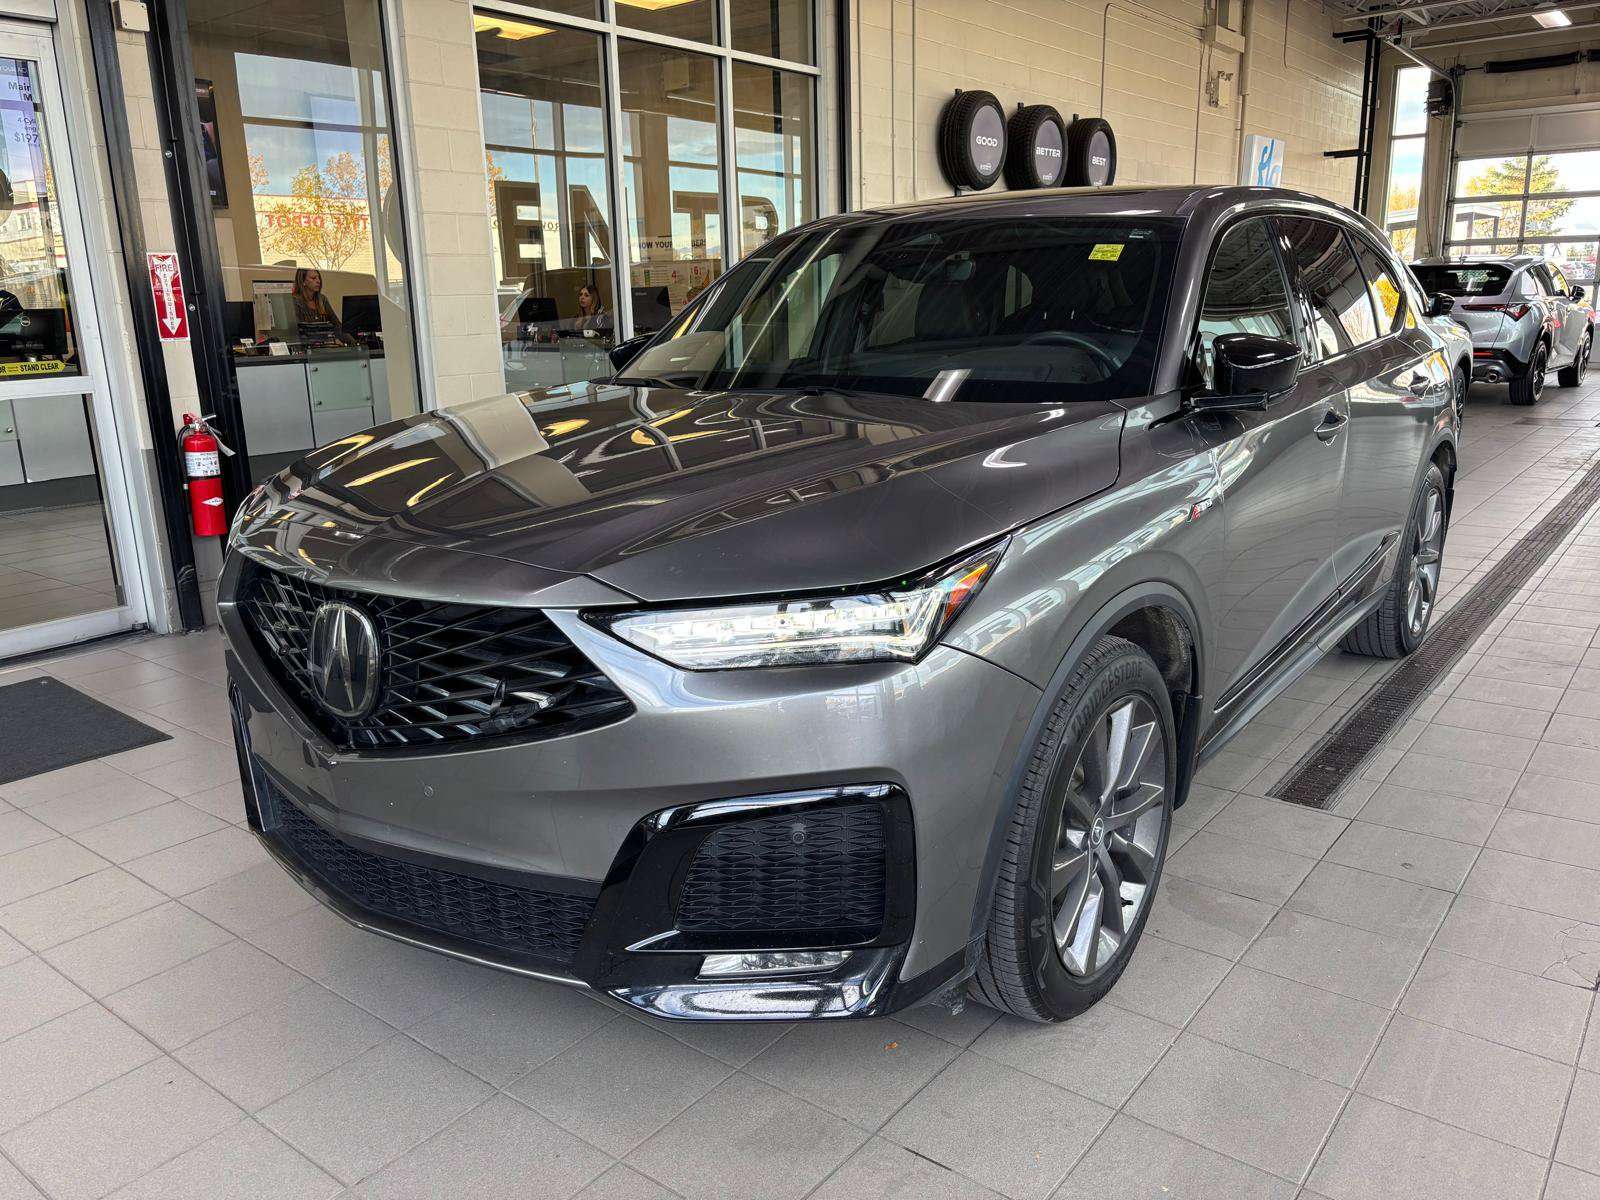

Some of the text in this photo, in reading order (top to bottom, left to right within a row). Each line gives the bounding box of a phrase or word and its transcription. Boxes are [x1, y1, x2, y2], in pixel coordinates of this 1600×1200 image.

[976, 136, 998, 147] GOOD
[1035, 147, 1062, 157] BETTER
[1091, 156, 1107, 166] BEST
[155, 264, 174, 272] FIRE
[20, 363, 40, 372] STAND
[41, 362, 60, 370] CLEAR
